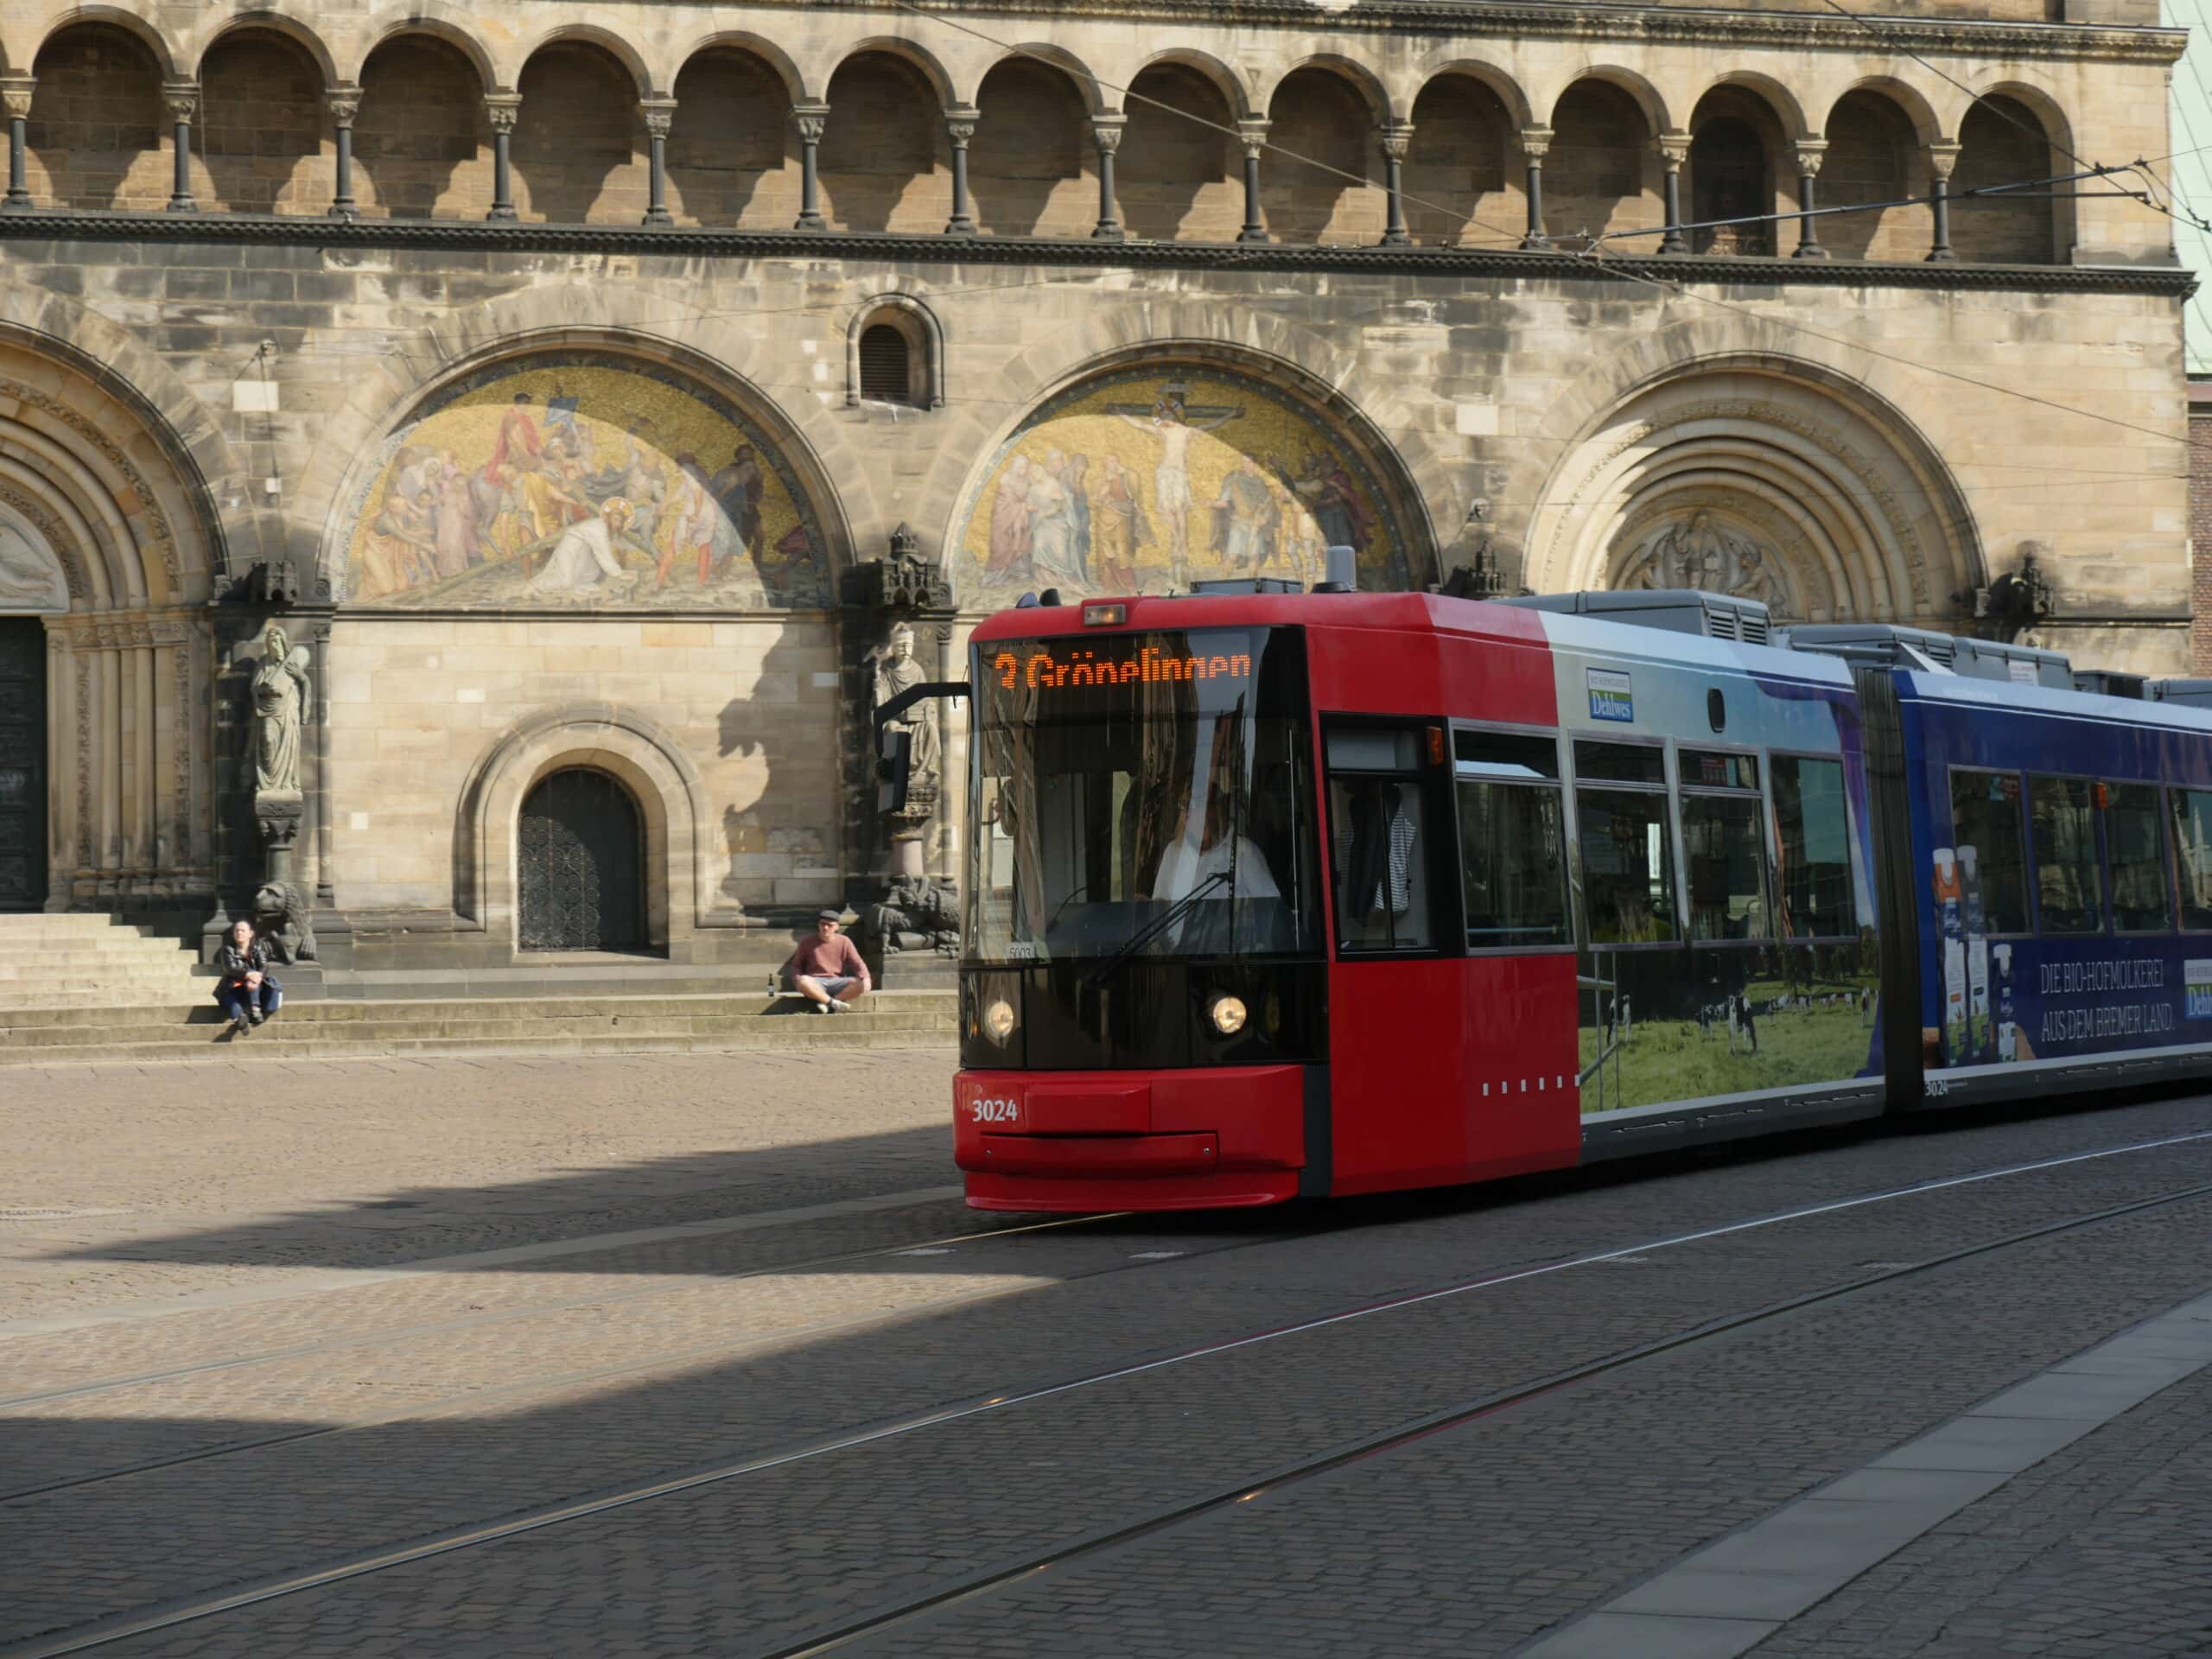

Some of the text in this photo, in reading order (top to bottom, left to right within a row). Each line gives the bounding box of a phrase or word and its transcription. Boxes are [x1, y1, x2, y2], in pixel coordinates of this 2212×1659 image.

[2040, 959, 2164, 995] DIE BIO-HOFMOLKEREI
[2041, 1009, 2066, 1043] AUS
[2068, 1007, 2094, 1040] DEM
[2096, 1005, 2141, 1037] BREMER
[2143, 1002, 2176, 1033] LAND.
[1924, 1078, 1948, 1096] 3024
[972, 1098, 1018, 1122] 3024
